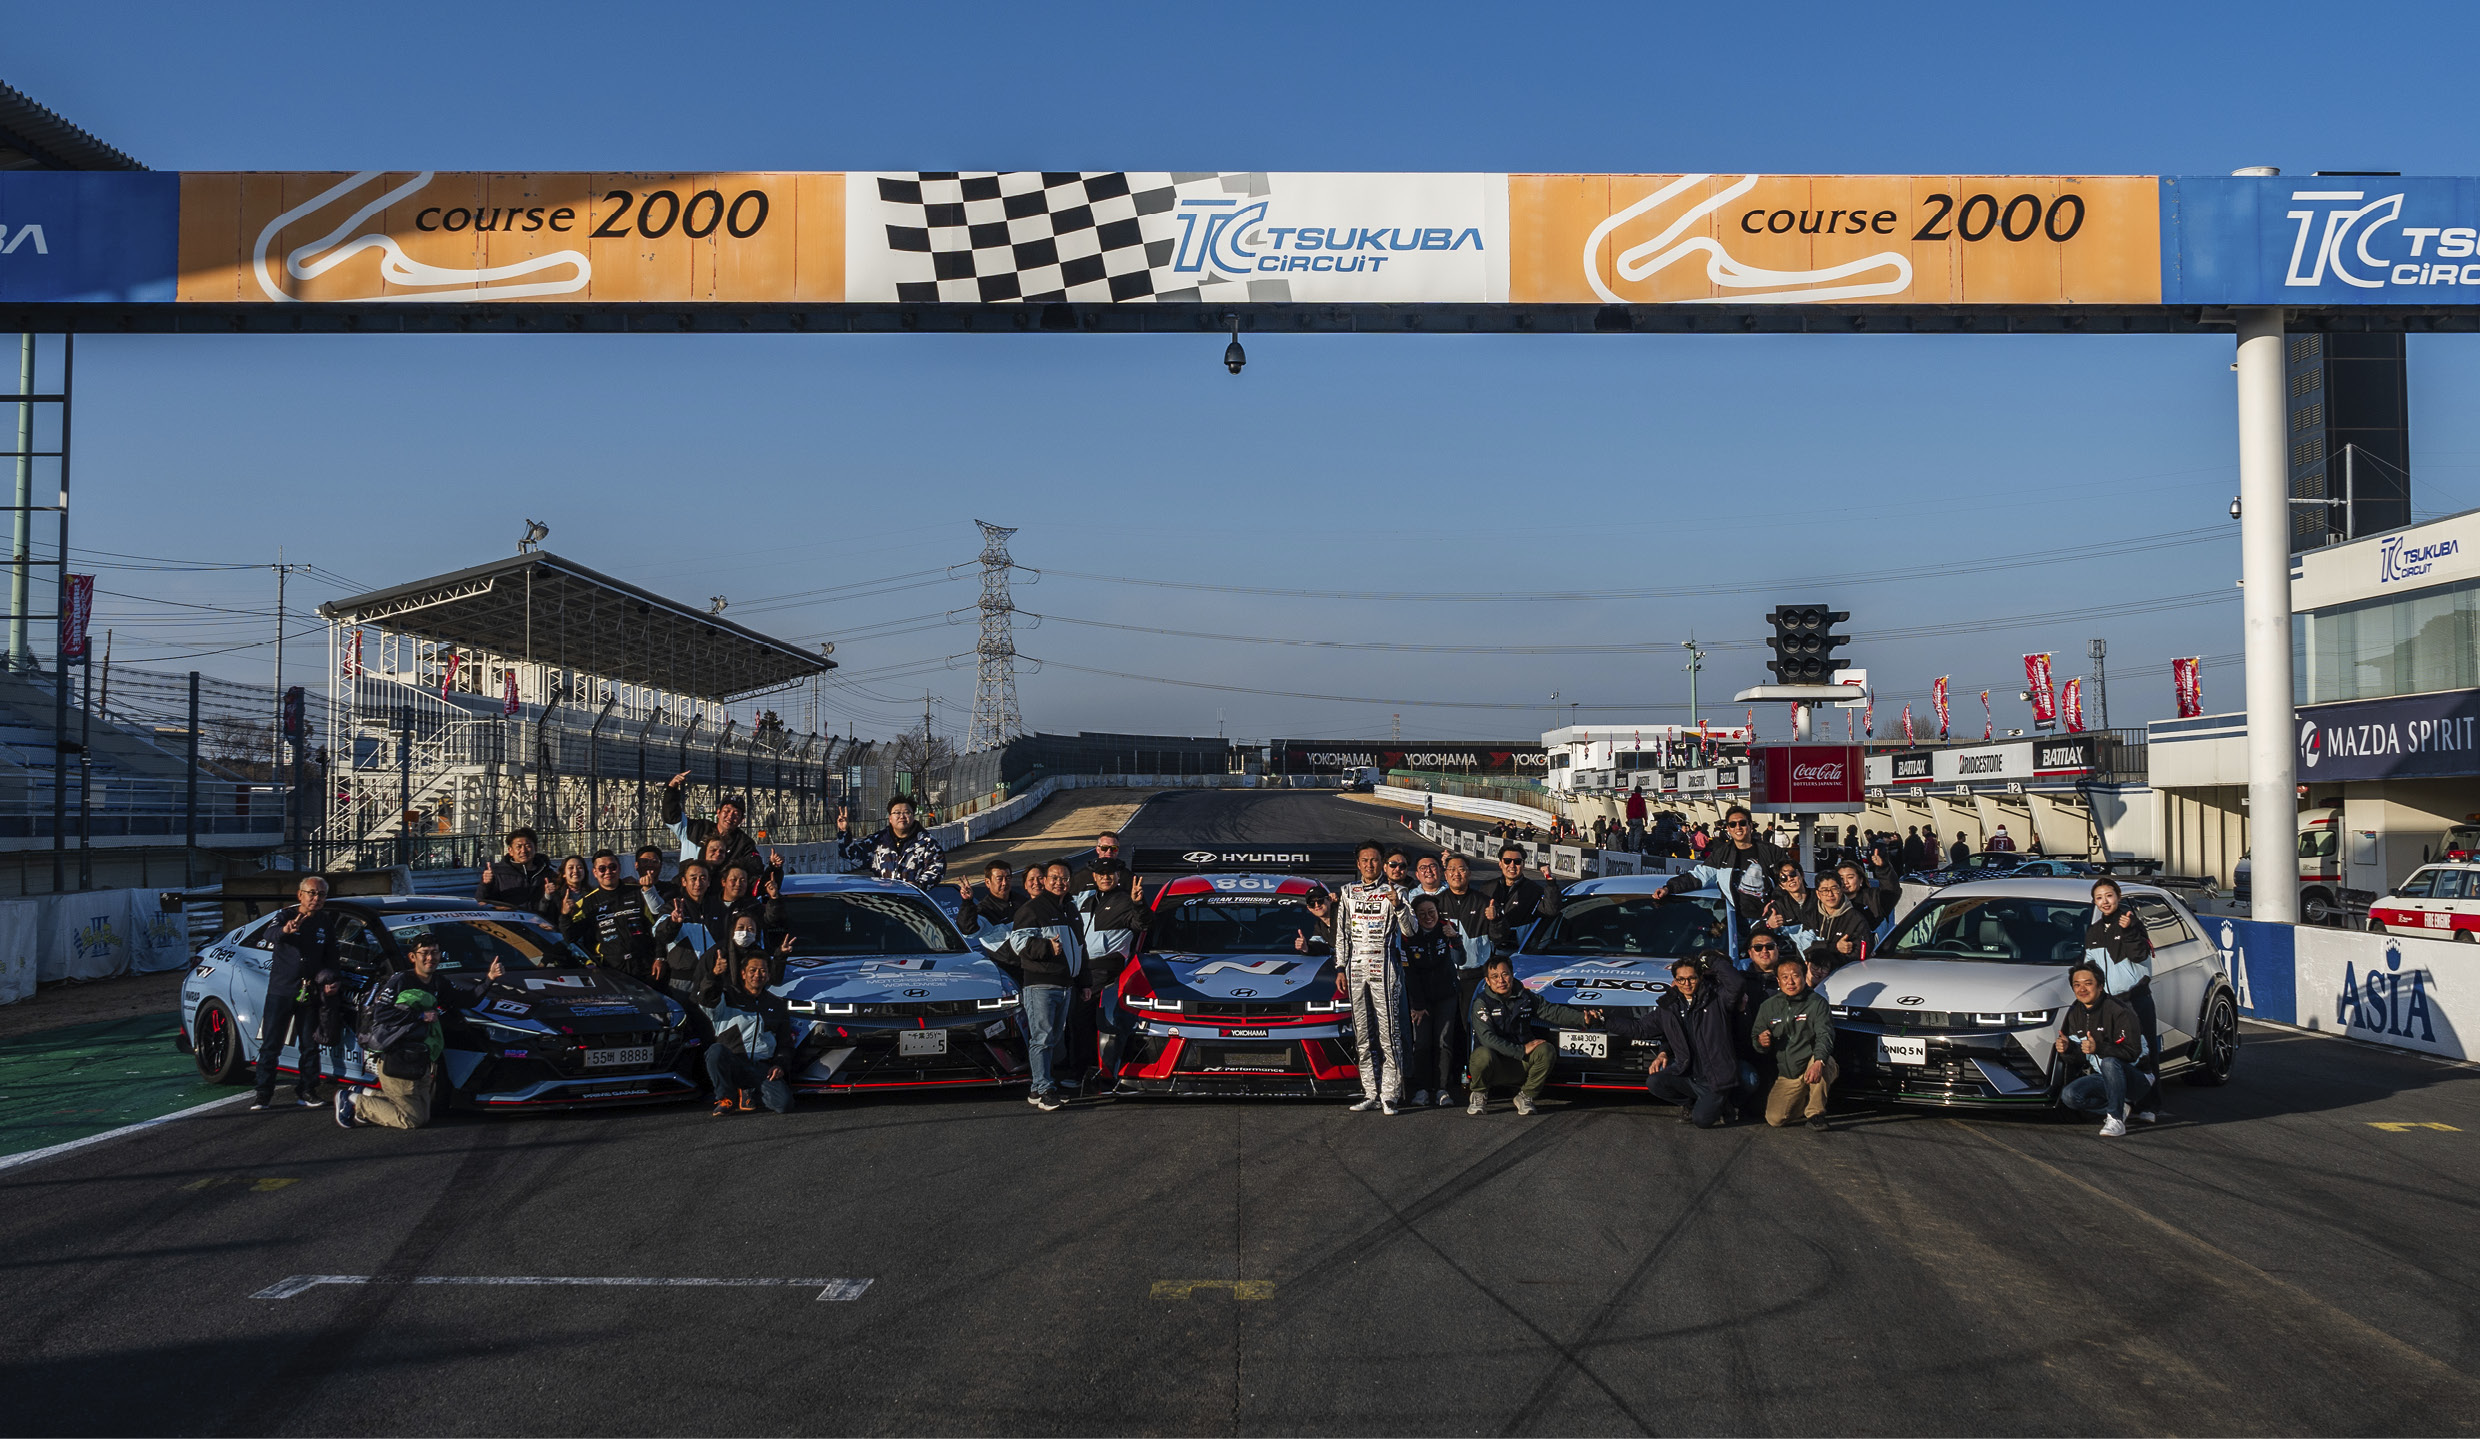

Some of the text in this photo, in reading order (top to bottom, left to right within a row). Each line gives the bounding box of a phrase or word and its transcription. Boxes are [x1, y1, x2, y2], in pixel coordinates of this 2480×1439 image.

[416, 190, 770, 239] course 2000
[1741, 194, 2086, 242] course 2000
[1266, 227, 1484, 251] TSUKUBA
[2403, 540, 2458, 565] TSUKUBA
[2328, 717, 2474, 757] MAZDA SPIRIT
[1306, 752, 1373, 766] YOKOHAMA
[1405, 752, 1478, 766] YOKOHAMA
[1959, 754, 2003, 775] BRIDGESTONE
[1793, 763, 1844, 781] Coca-Cola
[1898, 759, 1926, 776] BATTLAX
[1872, 786, 1884, 800] 16
[1911, 785, 1922, 799] 15
[1959, 783, 1971, 797] 14
[2008, 779, 2022, 794] 12
[1222, 854, 1310, 862] HYUNDAI
[1355, 901, 1382, 914] HKS
[2424, 912, 2435, 928] FIRE
[2435, 913, 2451, 929] ENGINE
[399, 930, 417, 938] ROK
[209, 946, 236, 963] there
[1552, 978, 1671, 993] CUSCO
[2337, 938, 2437, 1043] ASIA
[619, 1048, 650, 1065] 8888
[1570, 1043, 1605, 1056] 86-79
[1880, 1045, 1923, 1056] IONIQ 5 N
[612, 1091, 650, 1099] GARAGE
